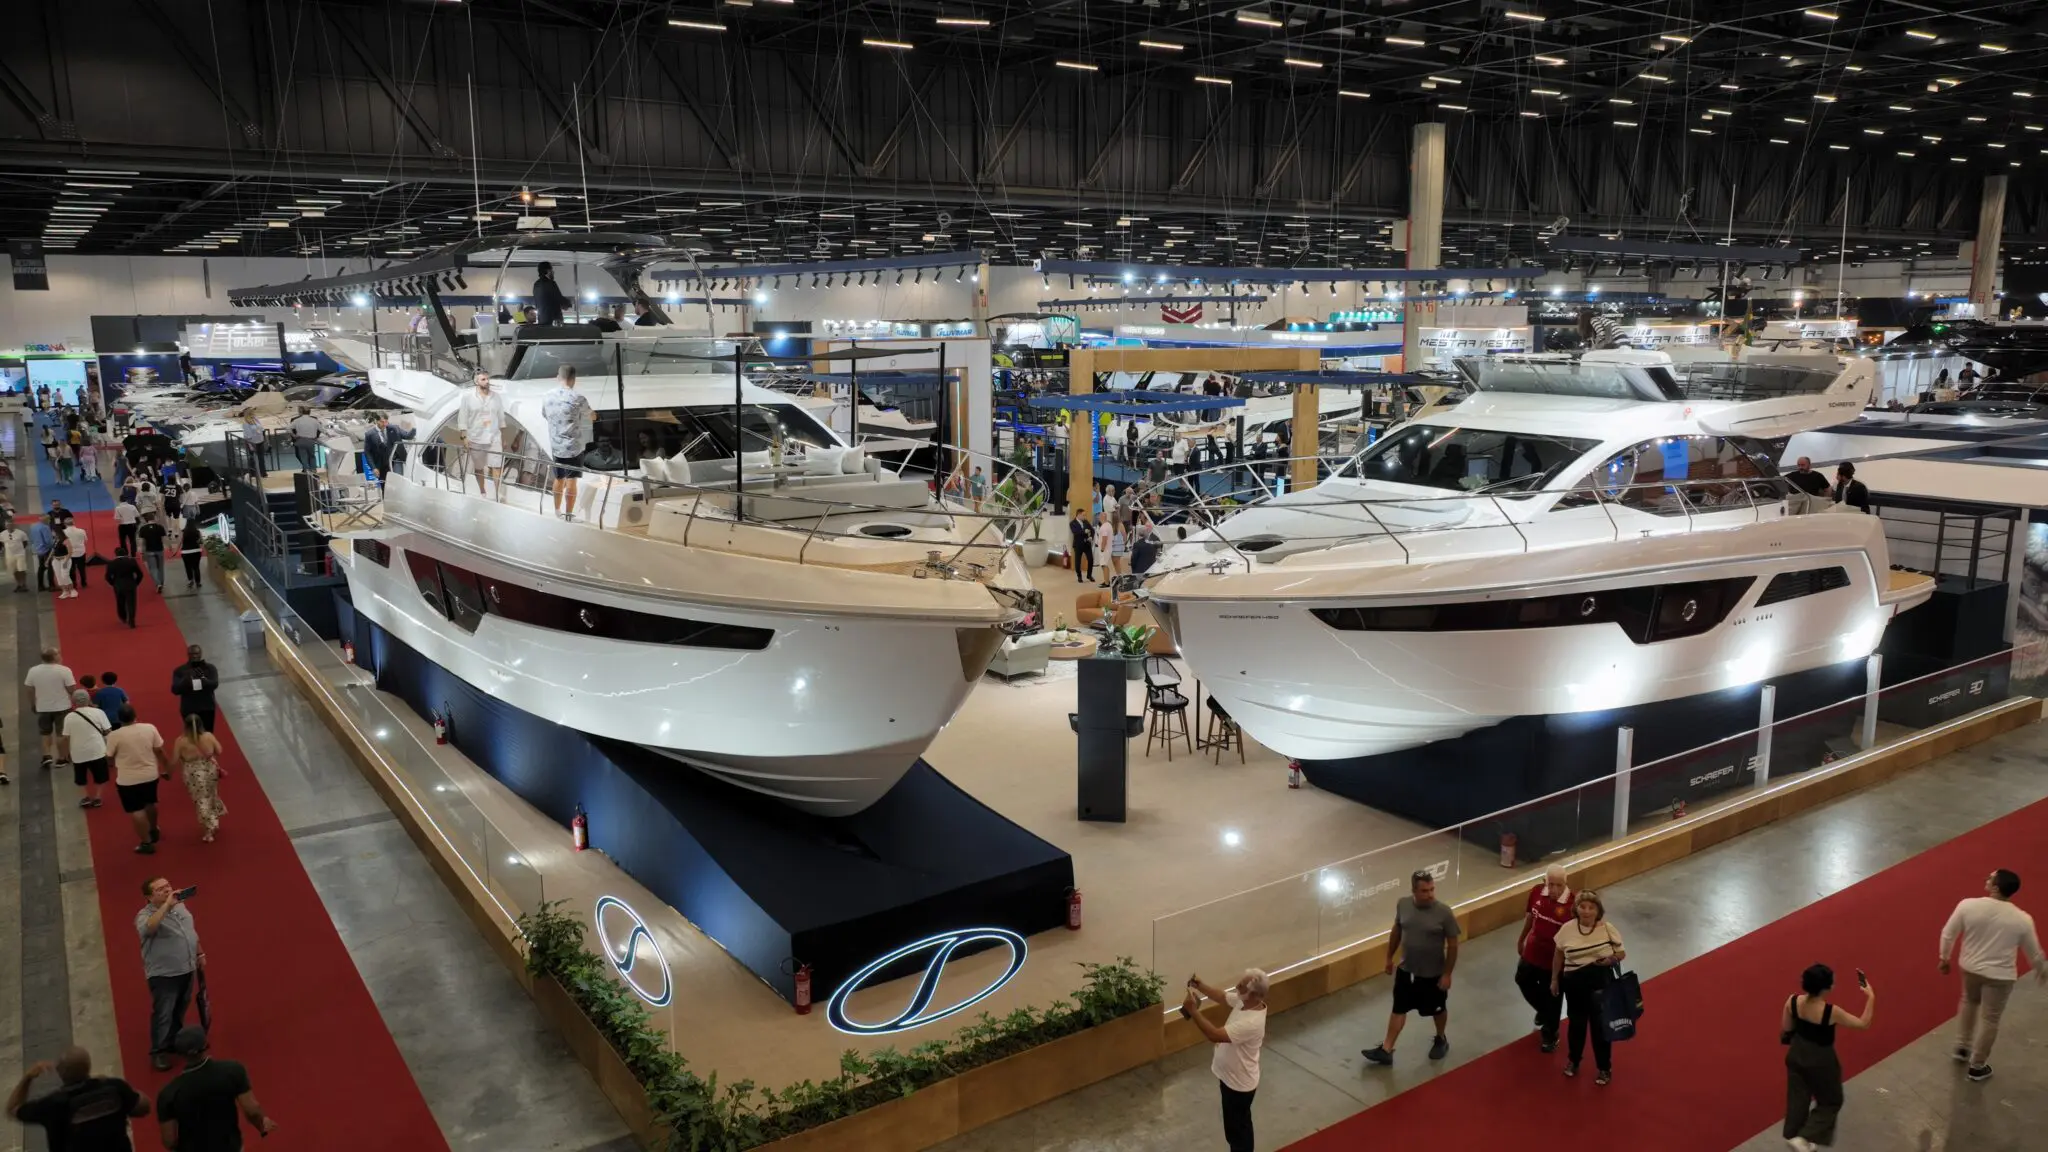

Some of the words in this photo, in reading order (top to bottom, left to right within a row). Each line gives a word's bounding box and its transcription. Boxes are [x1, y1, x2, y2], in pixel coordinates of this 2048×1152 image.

[24, 342, 66, 352] PARANÁ
[165, 489, 177, 497] 29
[1690, 765, 1734, 787] SCHAEFER
